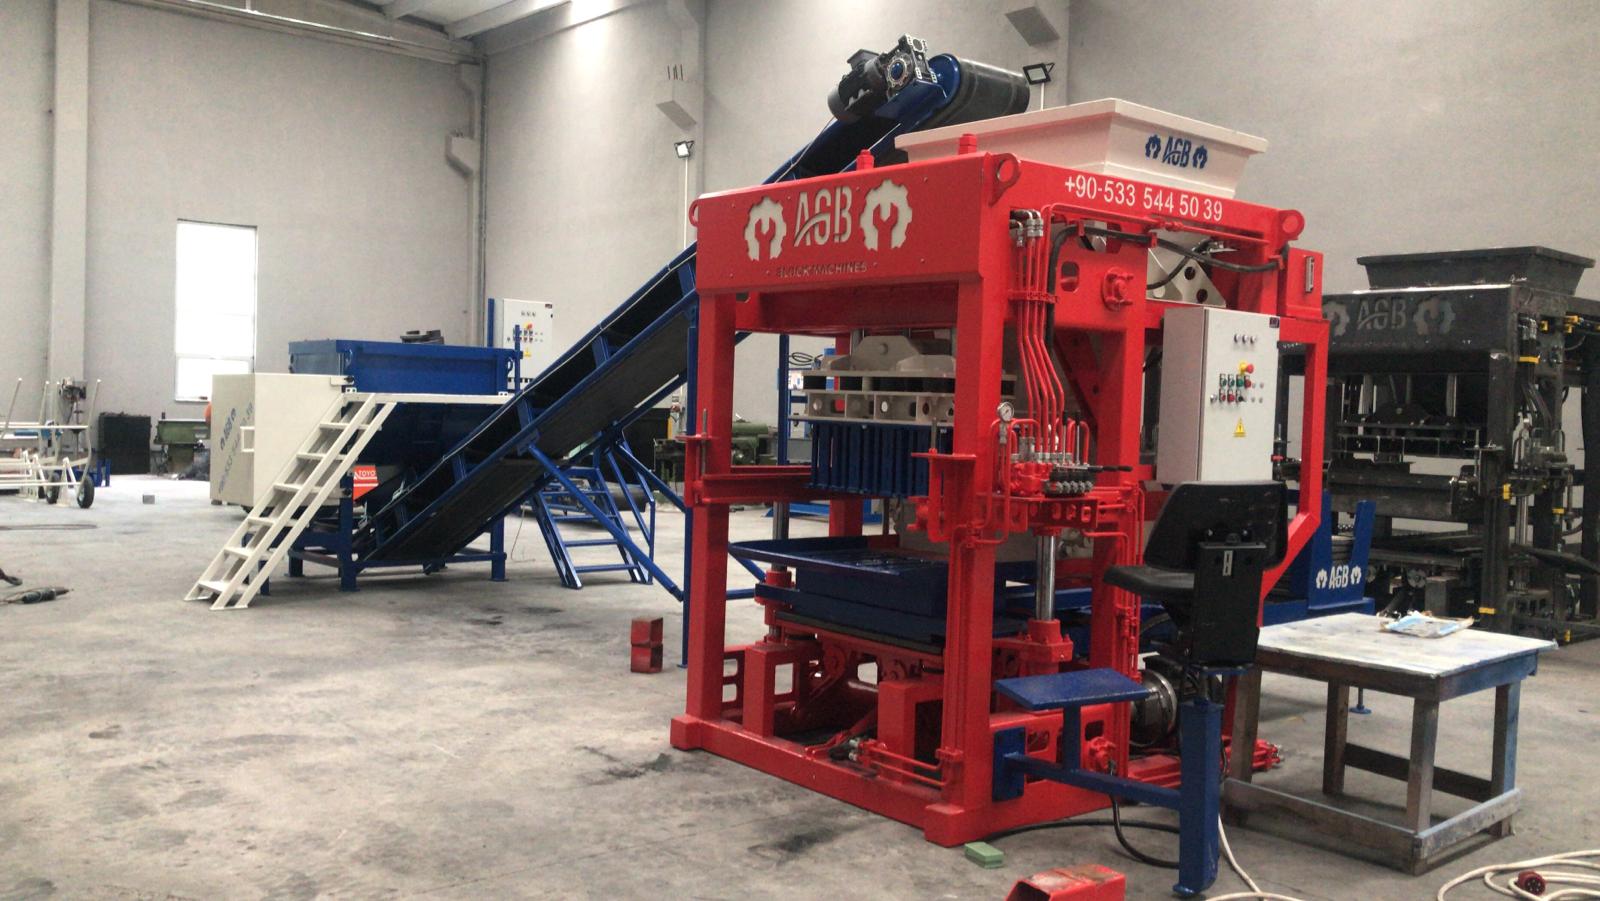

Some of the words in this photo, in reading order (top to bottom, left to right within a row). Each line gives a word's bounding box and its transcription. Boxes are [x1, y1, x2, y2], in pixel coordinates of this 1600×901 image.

[1162, 136, 1192, 168] AGB
[1065, 174, 1136, 207] +90-533
[1143, 187, 1174, 213] 544
[1179, 194, 1200, 218] 50
[1203, 198, 1223, 221] 39
[793, 186, 853, 247] AGB
[813, 261, 868, 275] MACHINES
[1357, 296, 1406, 331] AGB
[1328, 564, 1349, 590] AGB
